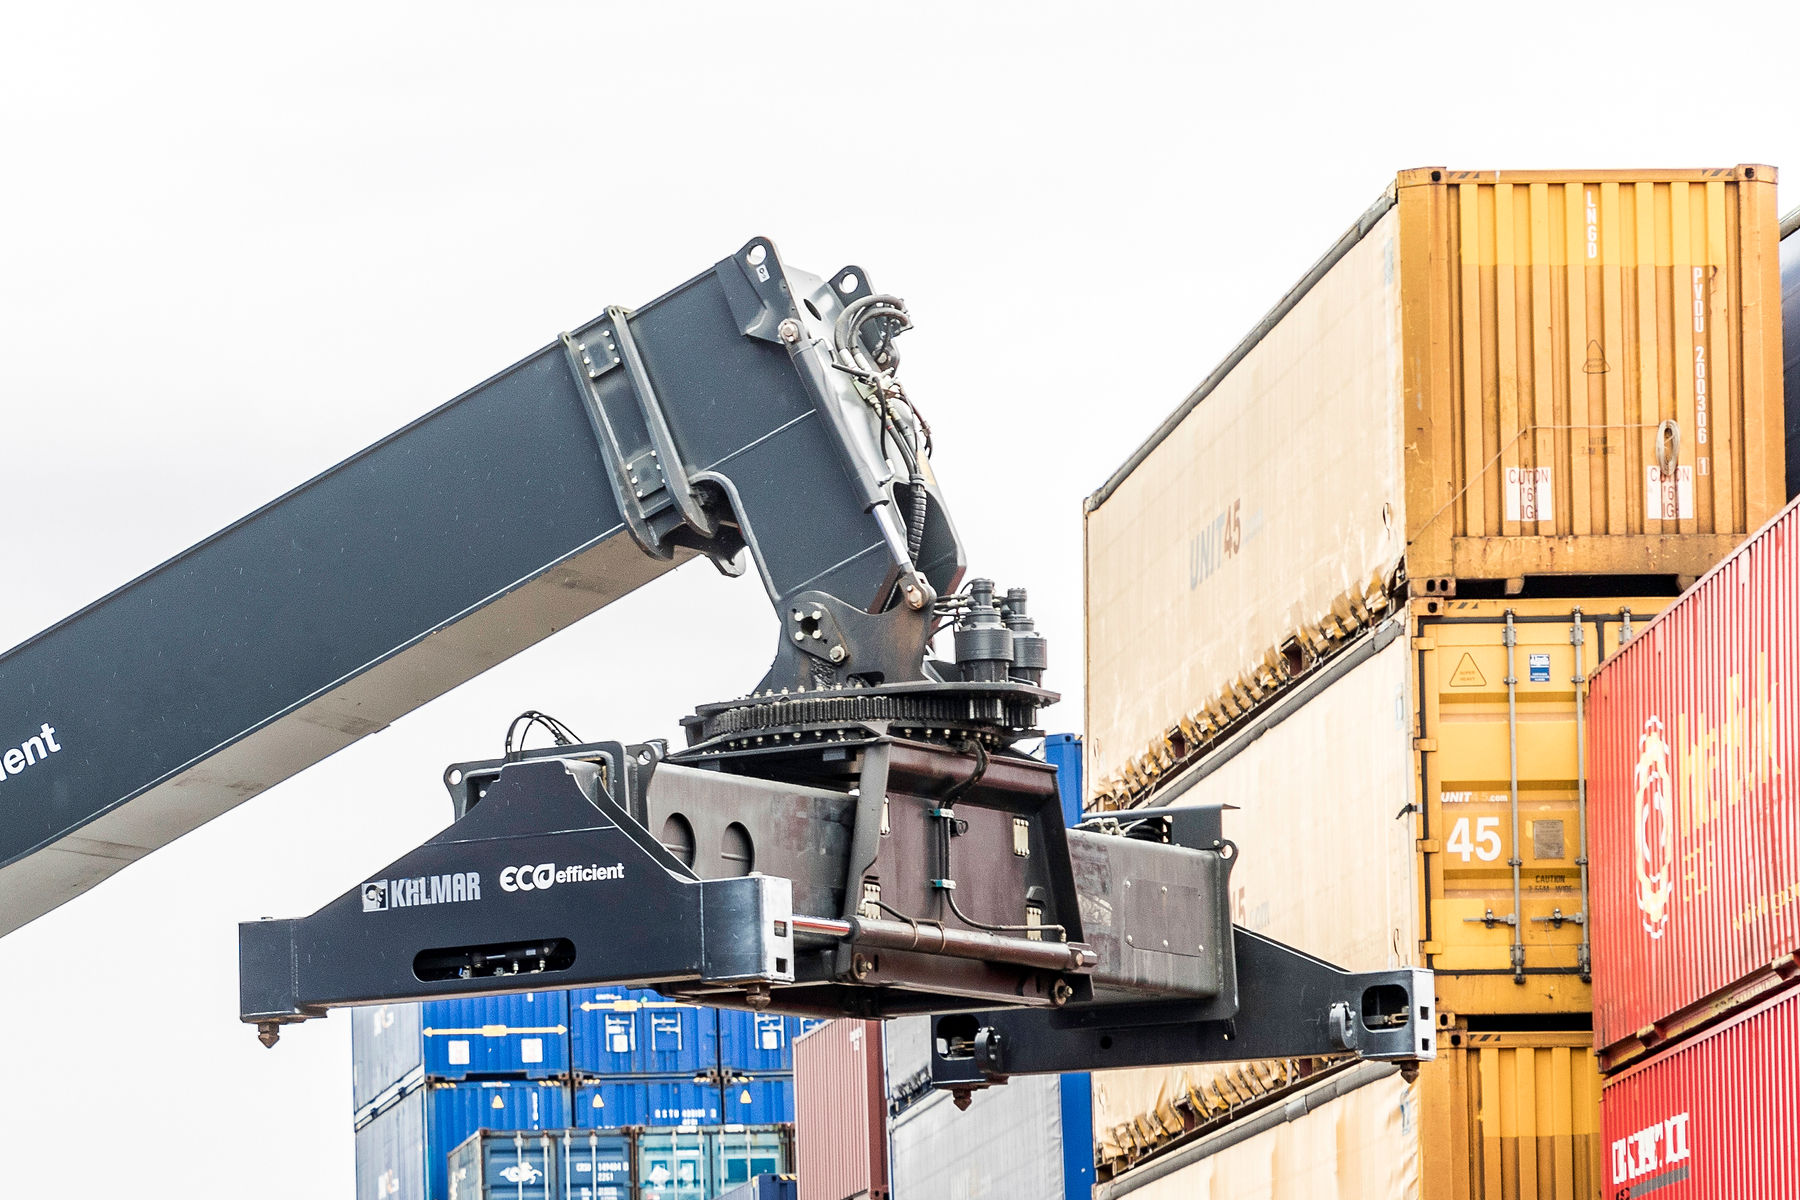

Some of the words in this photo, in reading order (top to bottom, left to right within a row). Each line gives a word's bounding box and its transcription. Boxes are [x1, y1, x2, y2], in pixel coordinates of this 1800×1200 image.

[1586, 191, 1598, 259] LNGD
[1693, 267, 1704, 333] PVDU
[1696, 346, 1707, 444] 200306
[1447, 817, 1502, 862] 45
[555, 863, 625, 883] efficient
[1535, 875, 1565, 884] CAUTION
